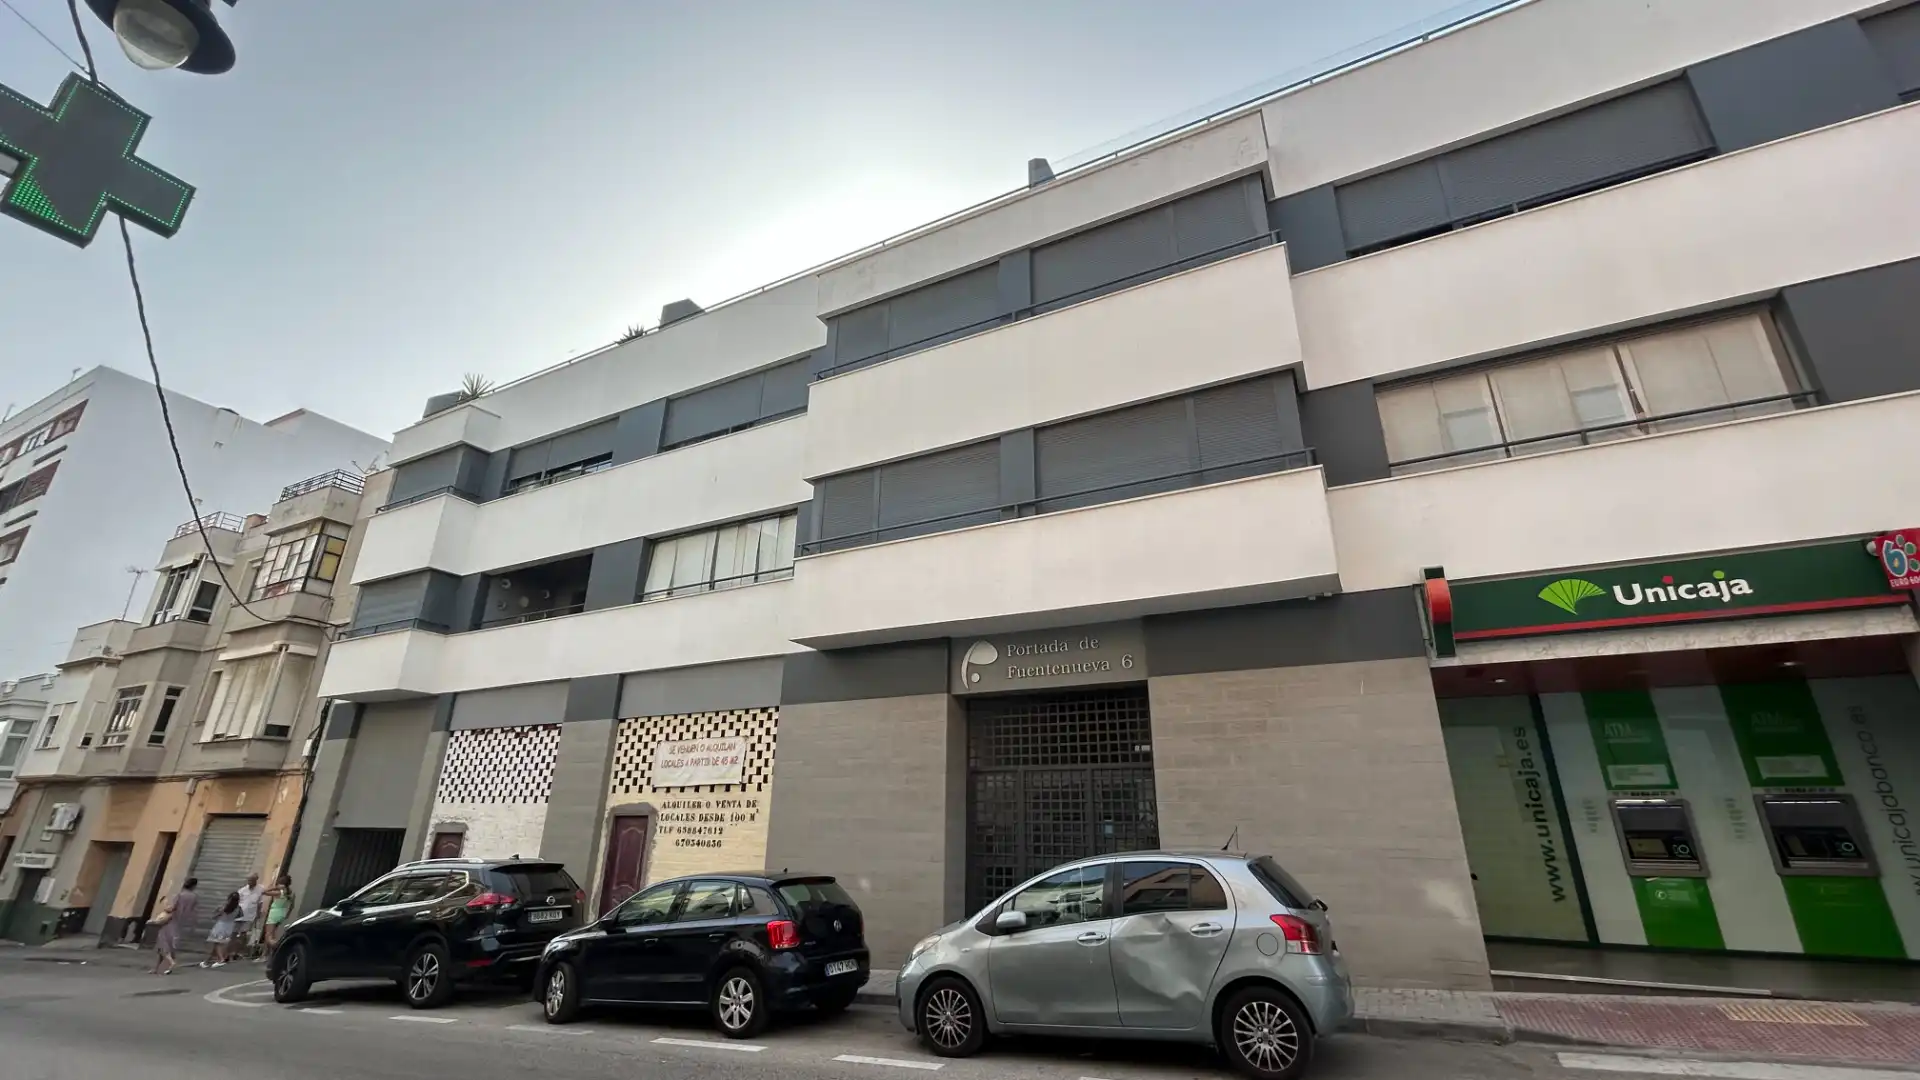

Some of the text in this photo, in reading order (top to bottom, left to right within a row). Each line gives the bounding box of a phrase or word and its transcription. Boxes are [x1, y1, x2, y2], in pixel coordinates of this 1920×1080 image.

[1612, 570, 1754, 606] Unicaja
[1006, 636, 1100, 657] Portada de
[1006, 653, 1133, 680] Fuentenueva 6
[668, 745, 676, 755] SE
[700, 744, 706, 753] O
[661, 759, 685, 769] LOCALES
[711, 756, 720, 767] DE
[661, 799, 757, 809] ALQUILER O VENTA DE
[660, 812, 695, 822] LOCALES
[699, 812, 725, 822] DESDE
[730, 812, 746, 822] 100
[1514, 726, 1566, 903] www.unicaja.es
